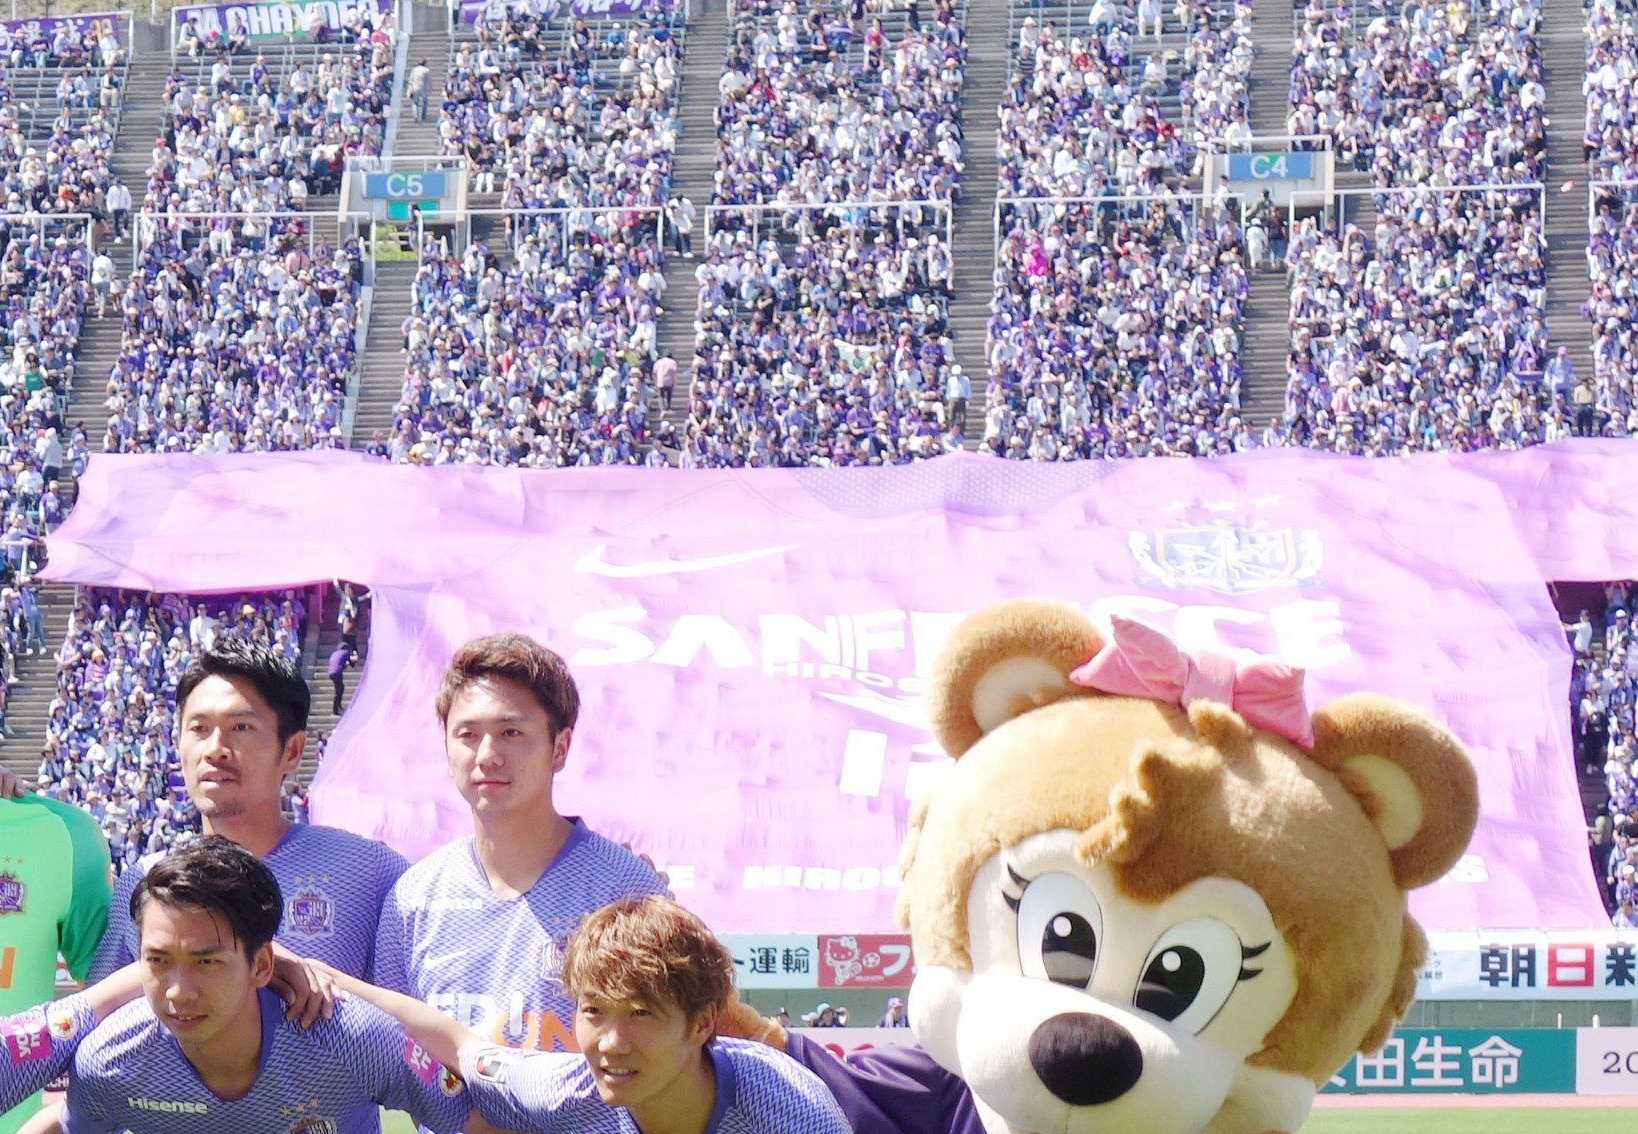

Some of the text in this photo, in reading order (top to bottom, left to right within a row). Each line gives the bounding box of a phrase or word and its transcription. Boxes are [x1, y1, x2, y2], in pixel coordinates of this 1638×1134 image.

[1250, 155, 1288, 178] C4
[386, 174, 423, 197] C5
[763, 662, 932, 693] HIROS
[1329, 1034, 1523, 1088] 田生命
[128, 1097, 208, 1115] Hisense
